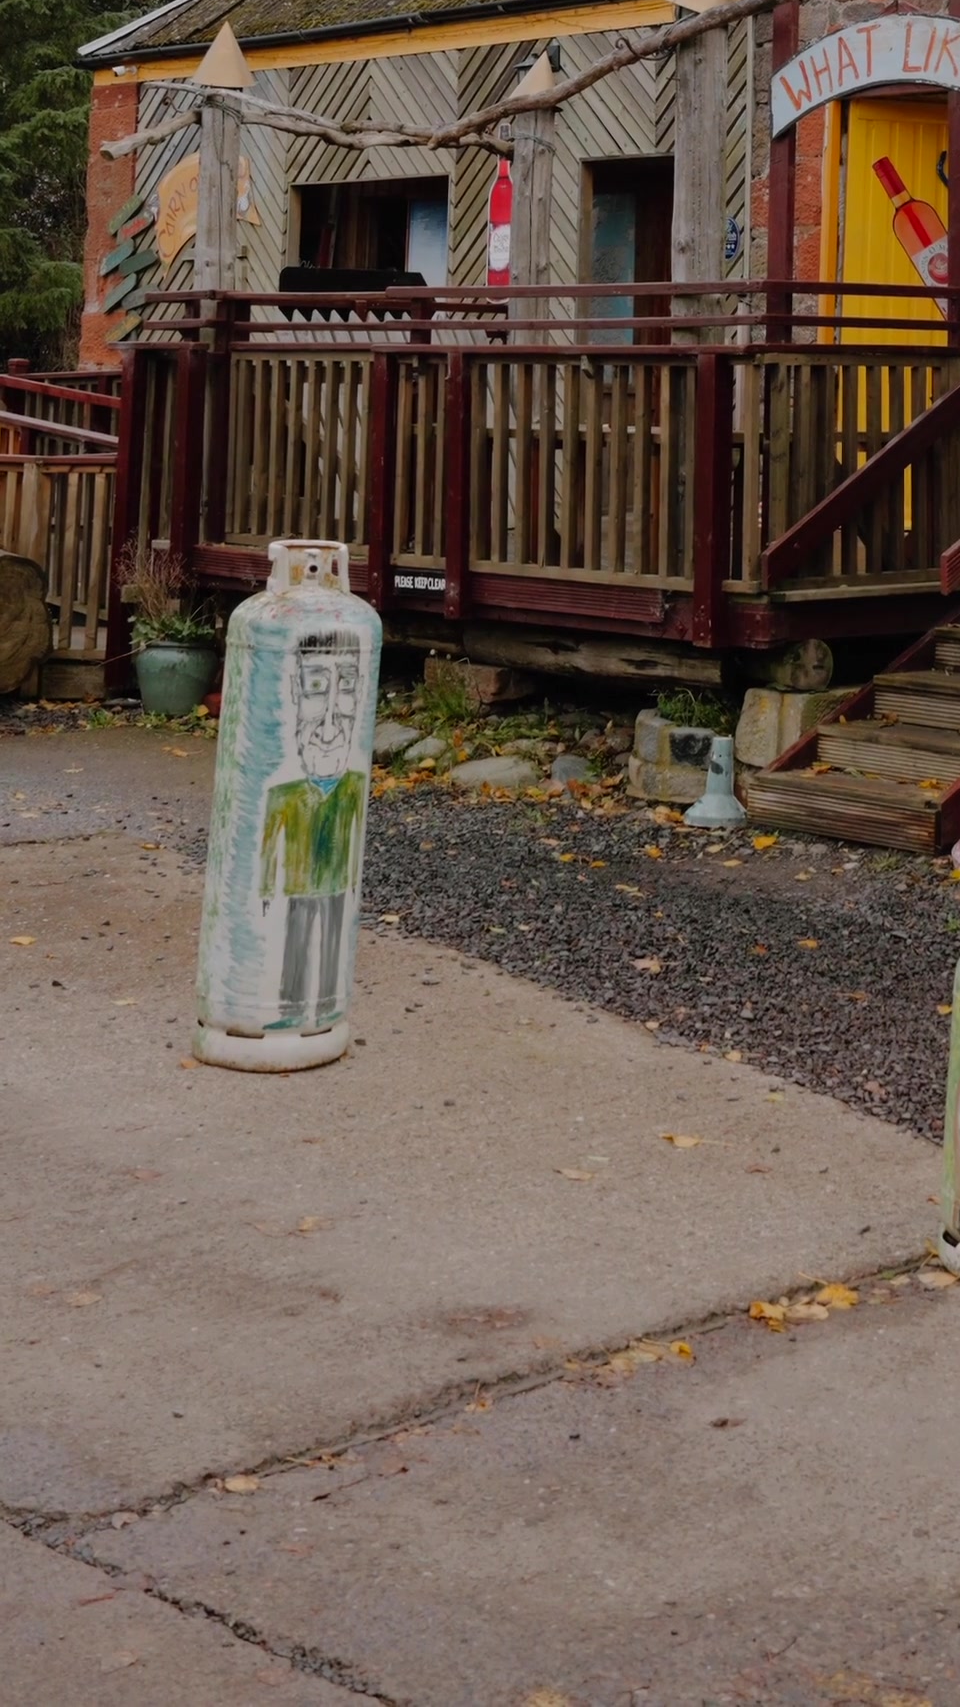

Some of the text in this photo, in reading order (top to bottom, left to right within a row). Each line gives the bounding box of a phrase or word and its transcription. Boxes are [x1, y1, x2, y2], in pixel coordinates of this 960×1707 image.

[779, 23, 882, 112] WHAT
[394, 575, 446, 591] PLEASE KEEP CLEAR
